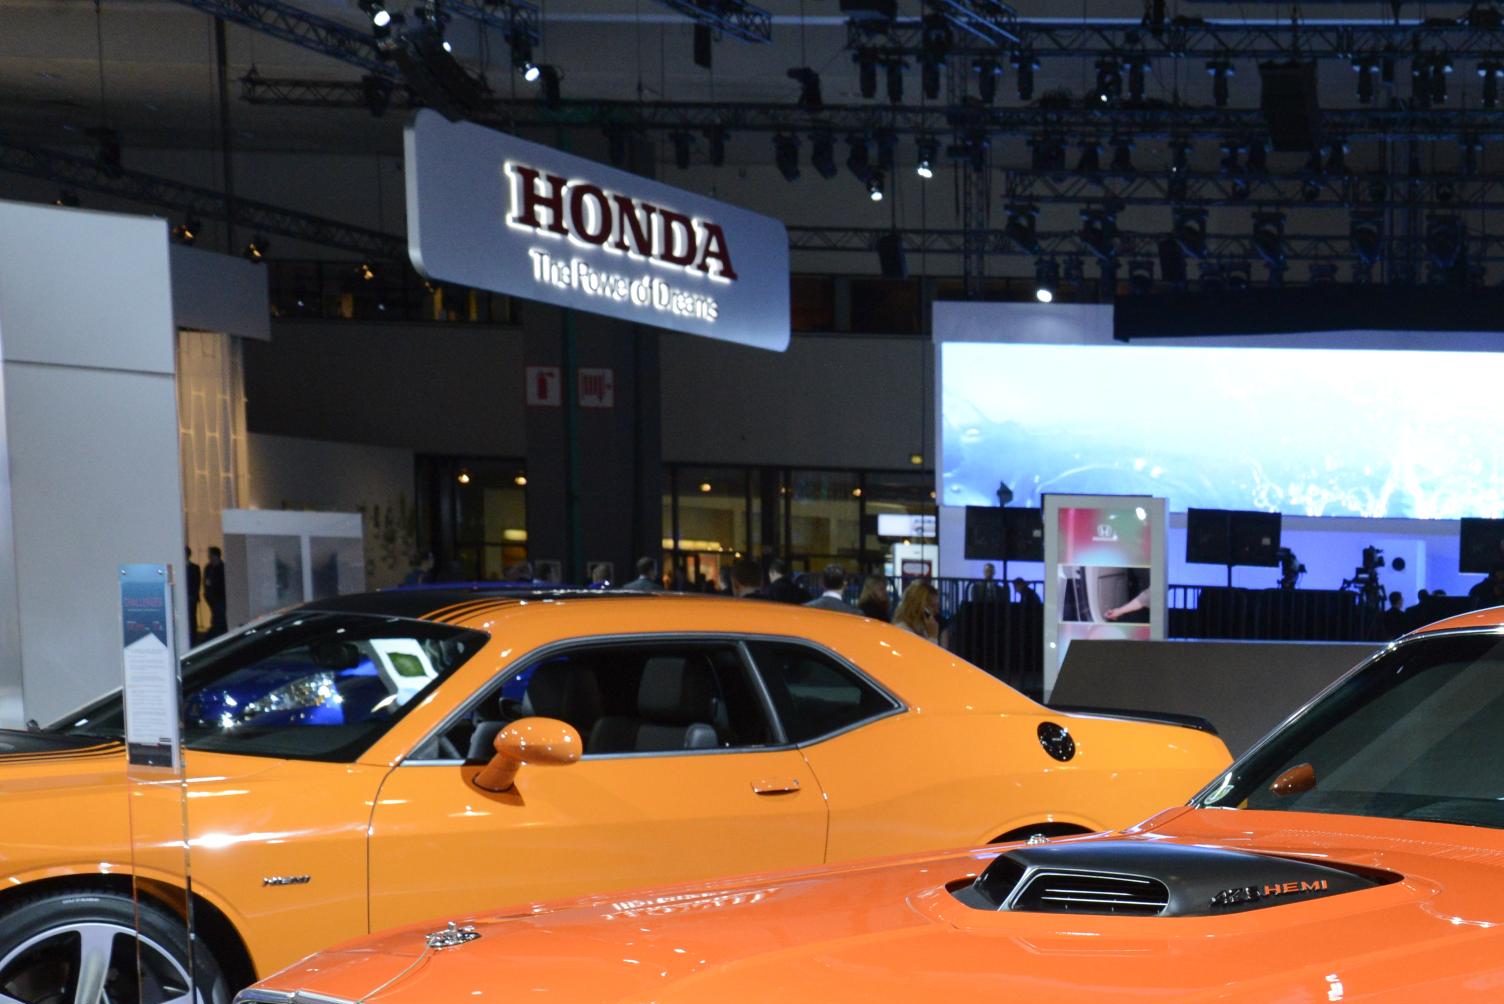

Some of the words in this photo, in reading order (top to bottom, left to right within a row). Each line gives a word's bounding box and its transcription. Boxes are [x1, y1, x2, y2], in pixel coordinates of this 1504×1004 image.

[506, 161, 738, 284] HONDA
[529, 249, 571, 288] The
[1264, 880, 1328, 896] HEMI
